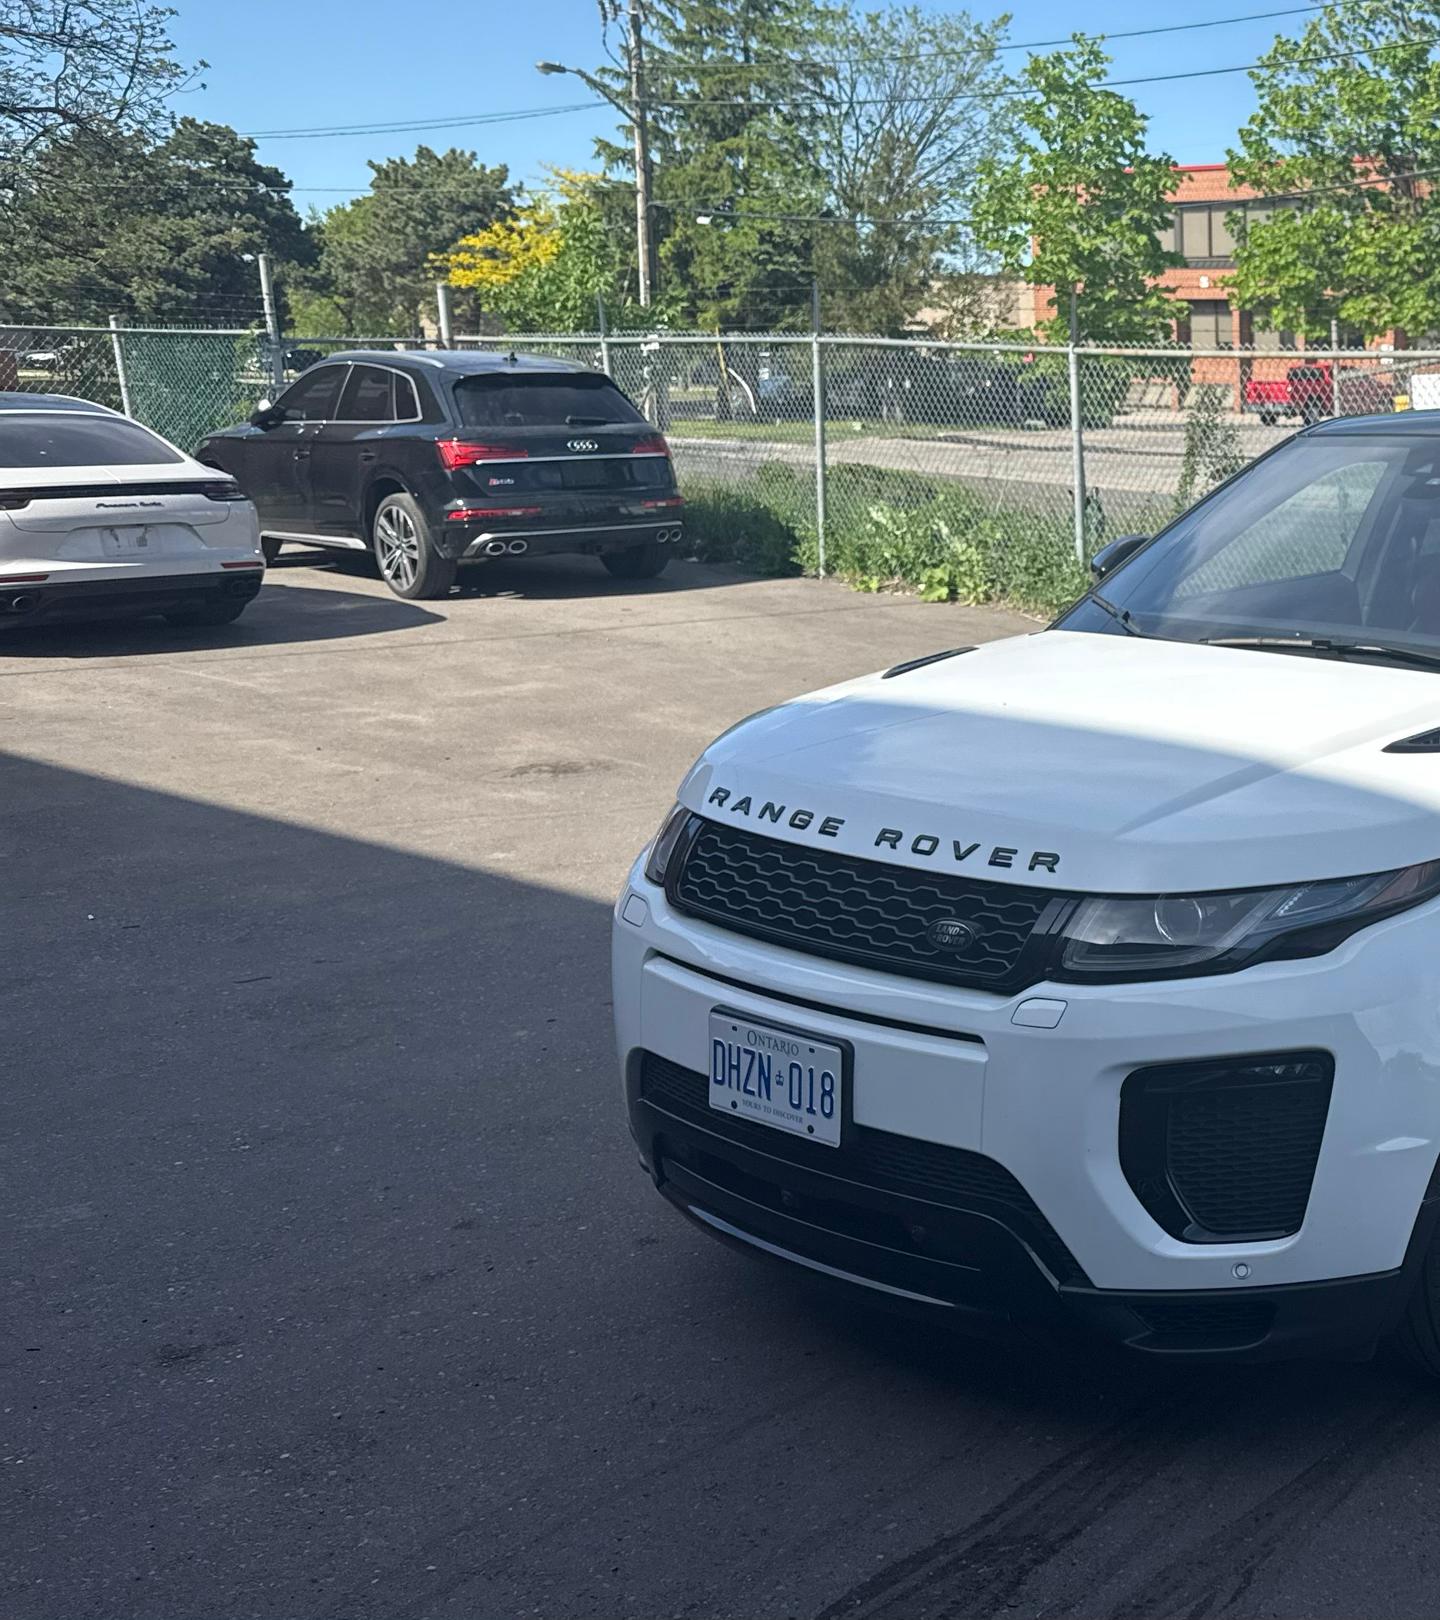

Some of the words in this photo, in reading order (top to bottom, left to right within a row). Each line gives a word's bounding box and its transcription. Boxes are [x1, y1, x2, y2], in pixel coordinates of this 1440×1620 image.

[708, 786, 846, 838] RANGE
[874, 827, 1061, 873] ROVER
[936, 924, 960, 936] LAND
[936, 935, 966, 945] ROVER
[747, 1030, 800, 1057] ONTARIO
[742, 1099, 762, 1111] YOURS
[763, 1105, 772, 1114] TO
[773, 1108, 803, 1124] DISCOVER
